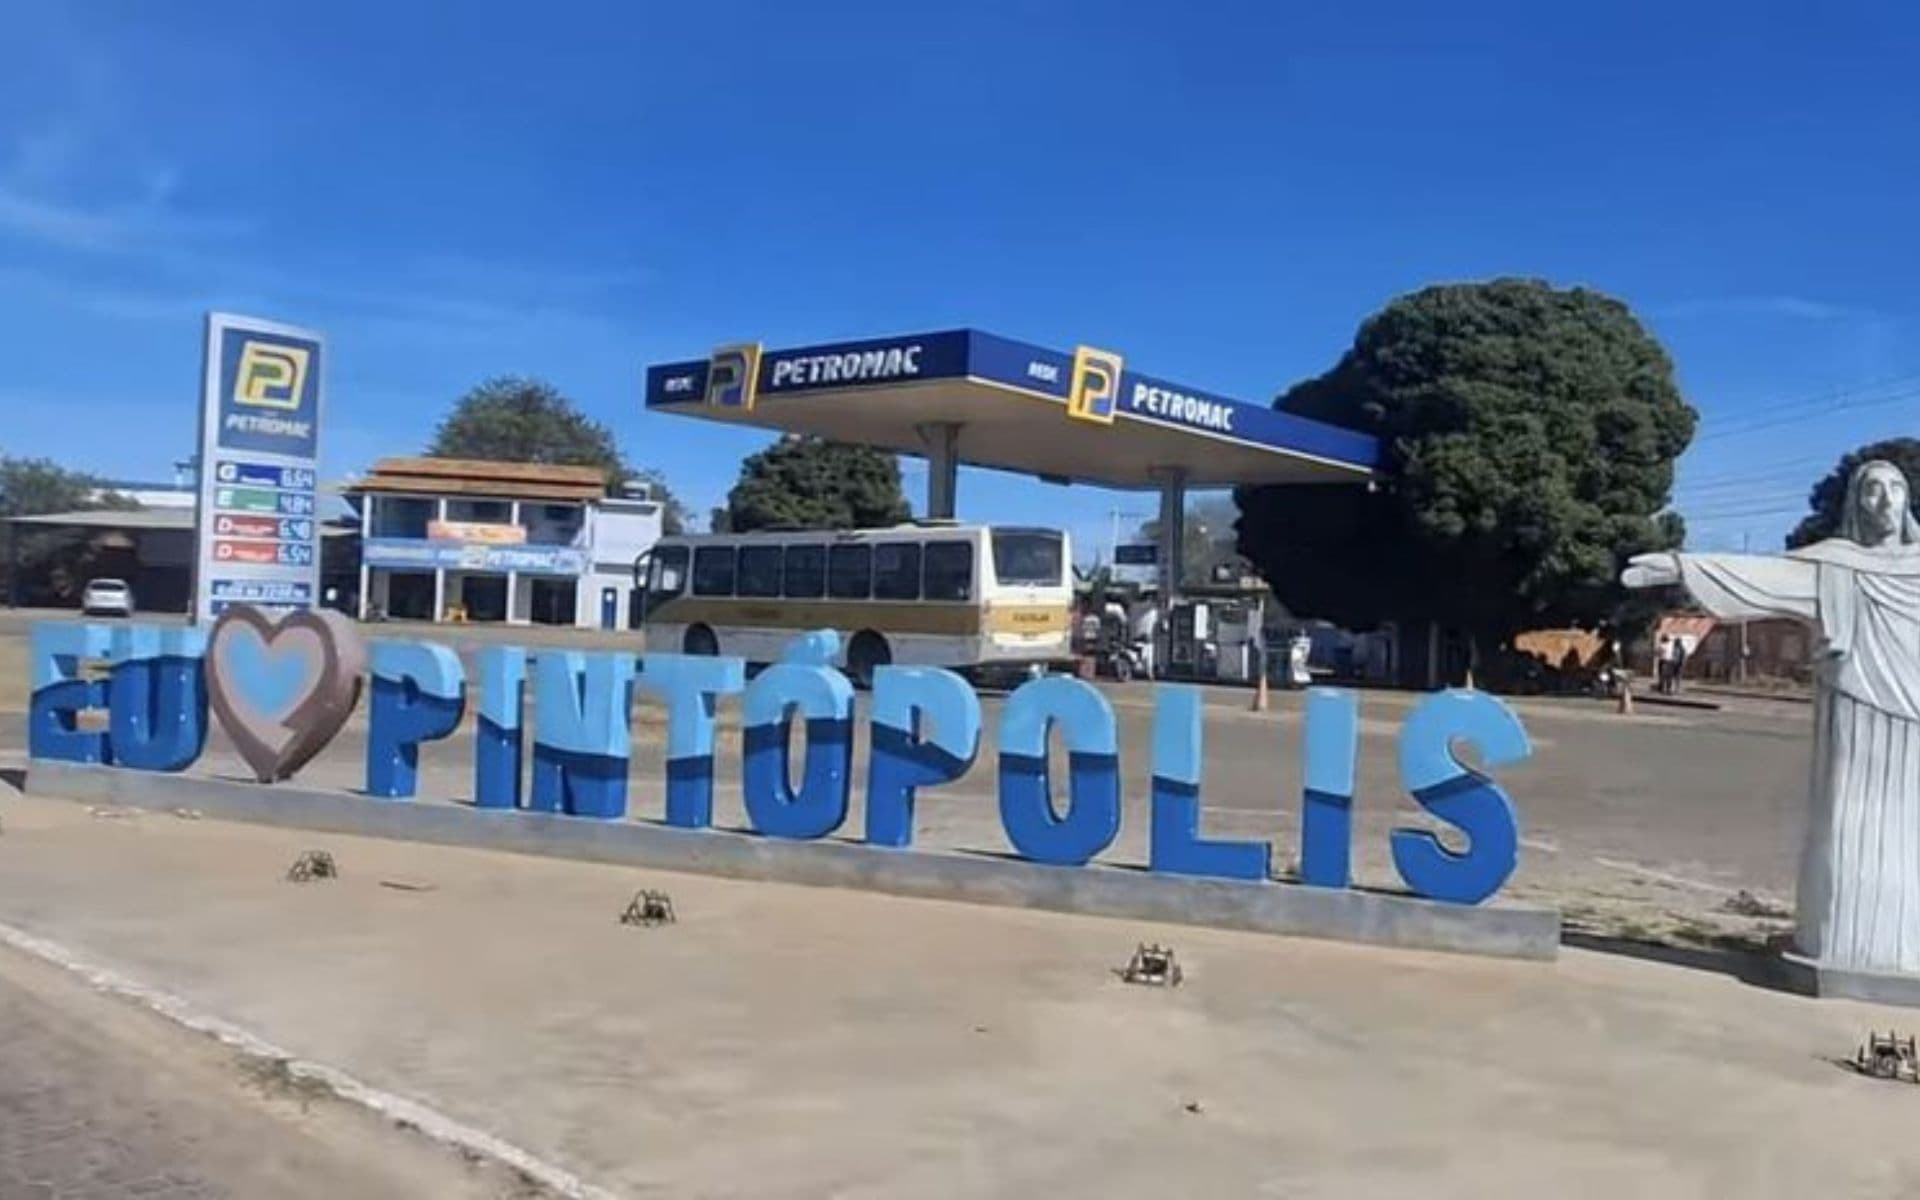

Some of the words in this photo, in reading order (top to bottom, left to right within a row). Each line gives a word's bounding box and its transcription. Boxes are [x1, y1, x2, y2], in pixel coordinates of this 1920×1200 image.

[771, 345, 923, 387] PETROMAC
[1132, 383, 1235, 432] PETROMAC
[28, 621, 209, 772] EU
[366, 629, 1532, 906] PINTÓPOLIS
